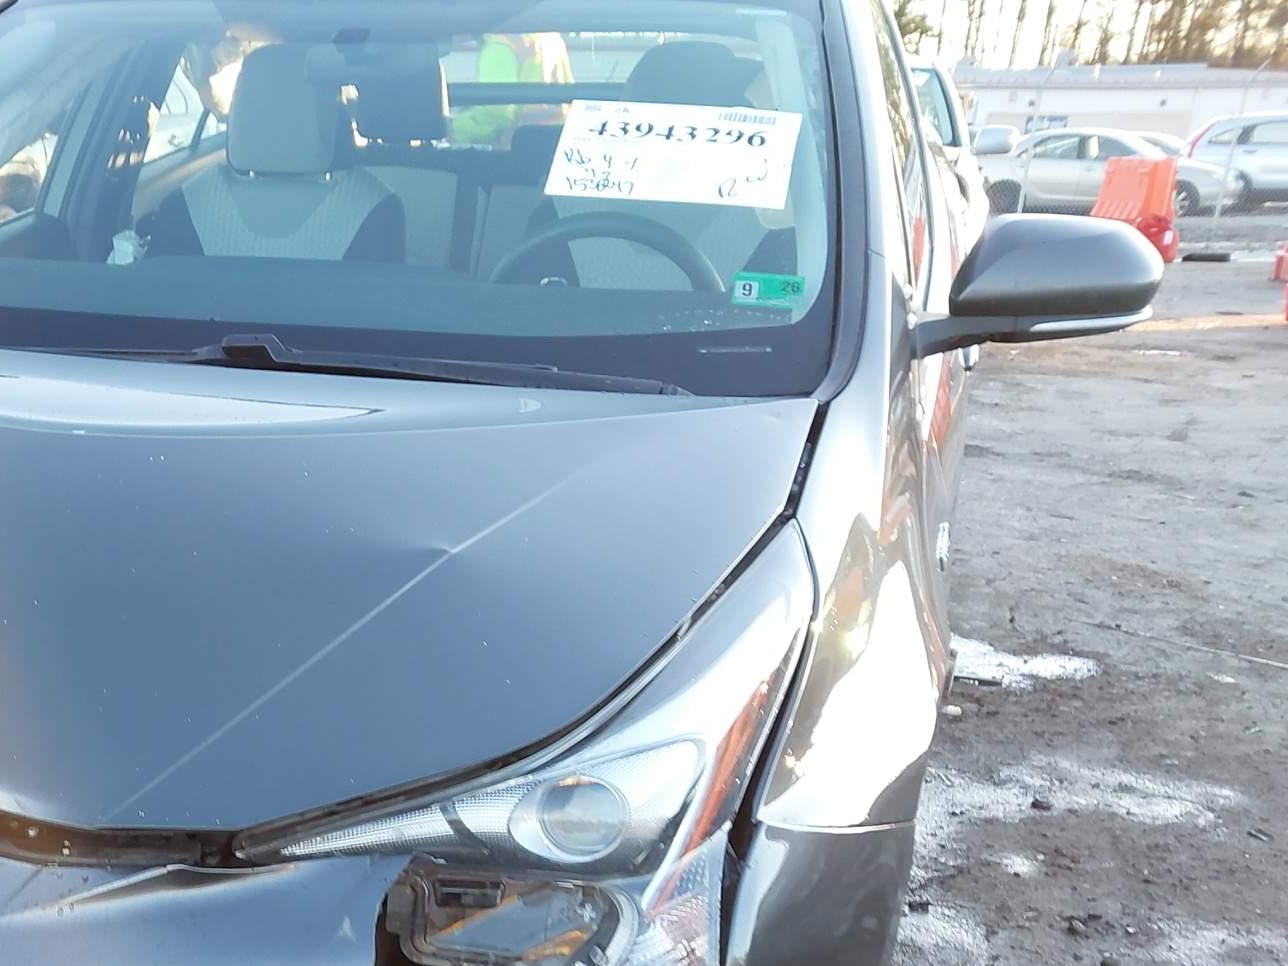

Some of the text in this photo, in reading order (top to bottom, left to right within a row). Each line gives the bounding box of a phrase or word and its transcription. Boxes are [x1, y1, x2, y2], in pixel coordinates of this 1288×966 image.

[588, 119, 769, 147] 43943296
[741, 280, 801, 297] 9 26
